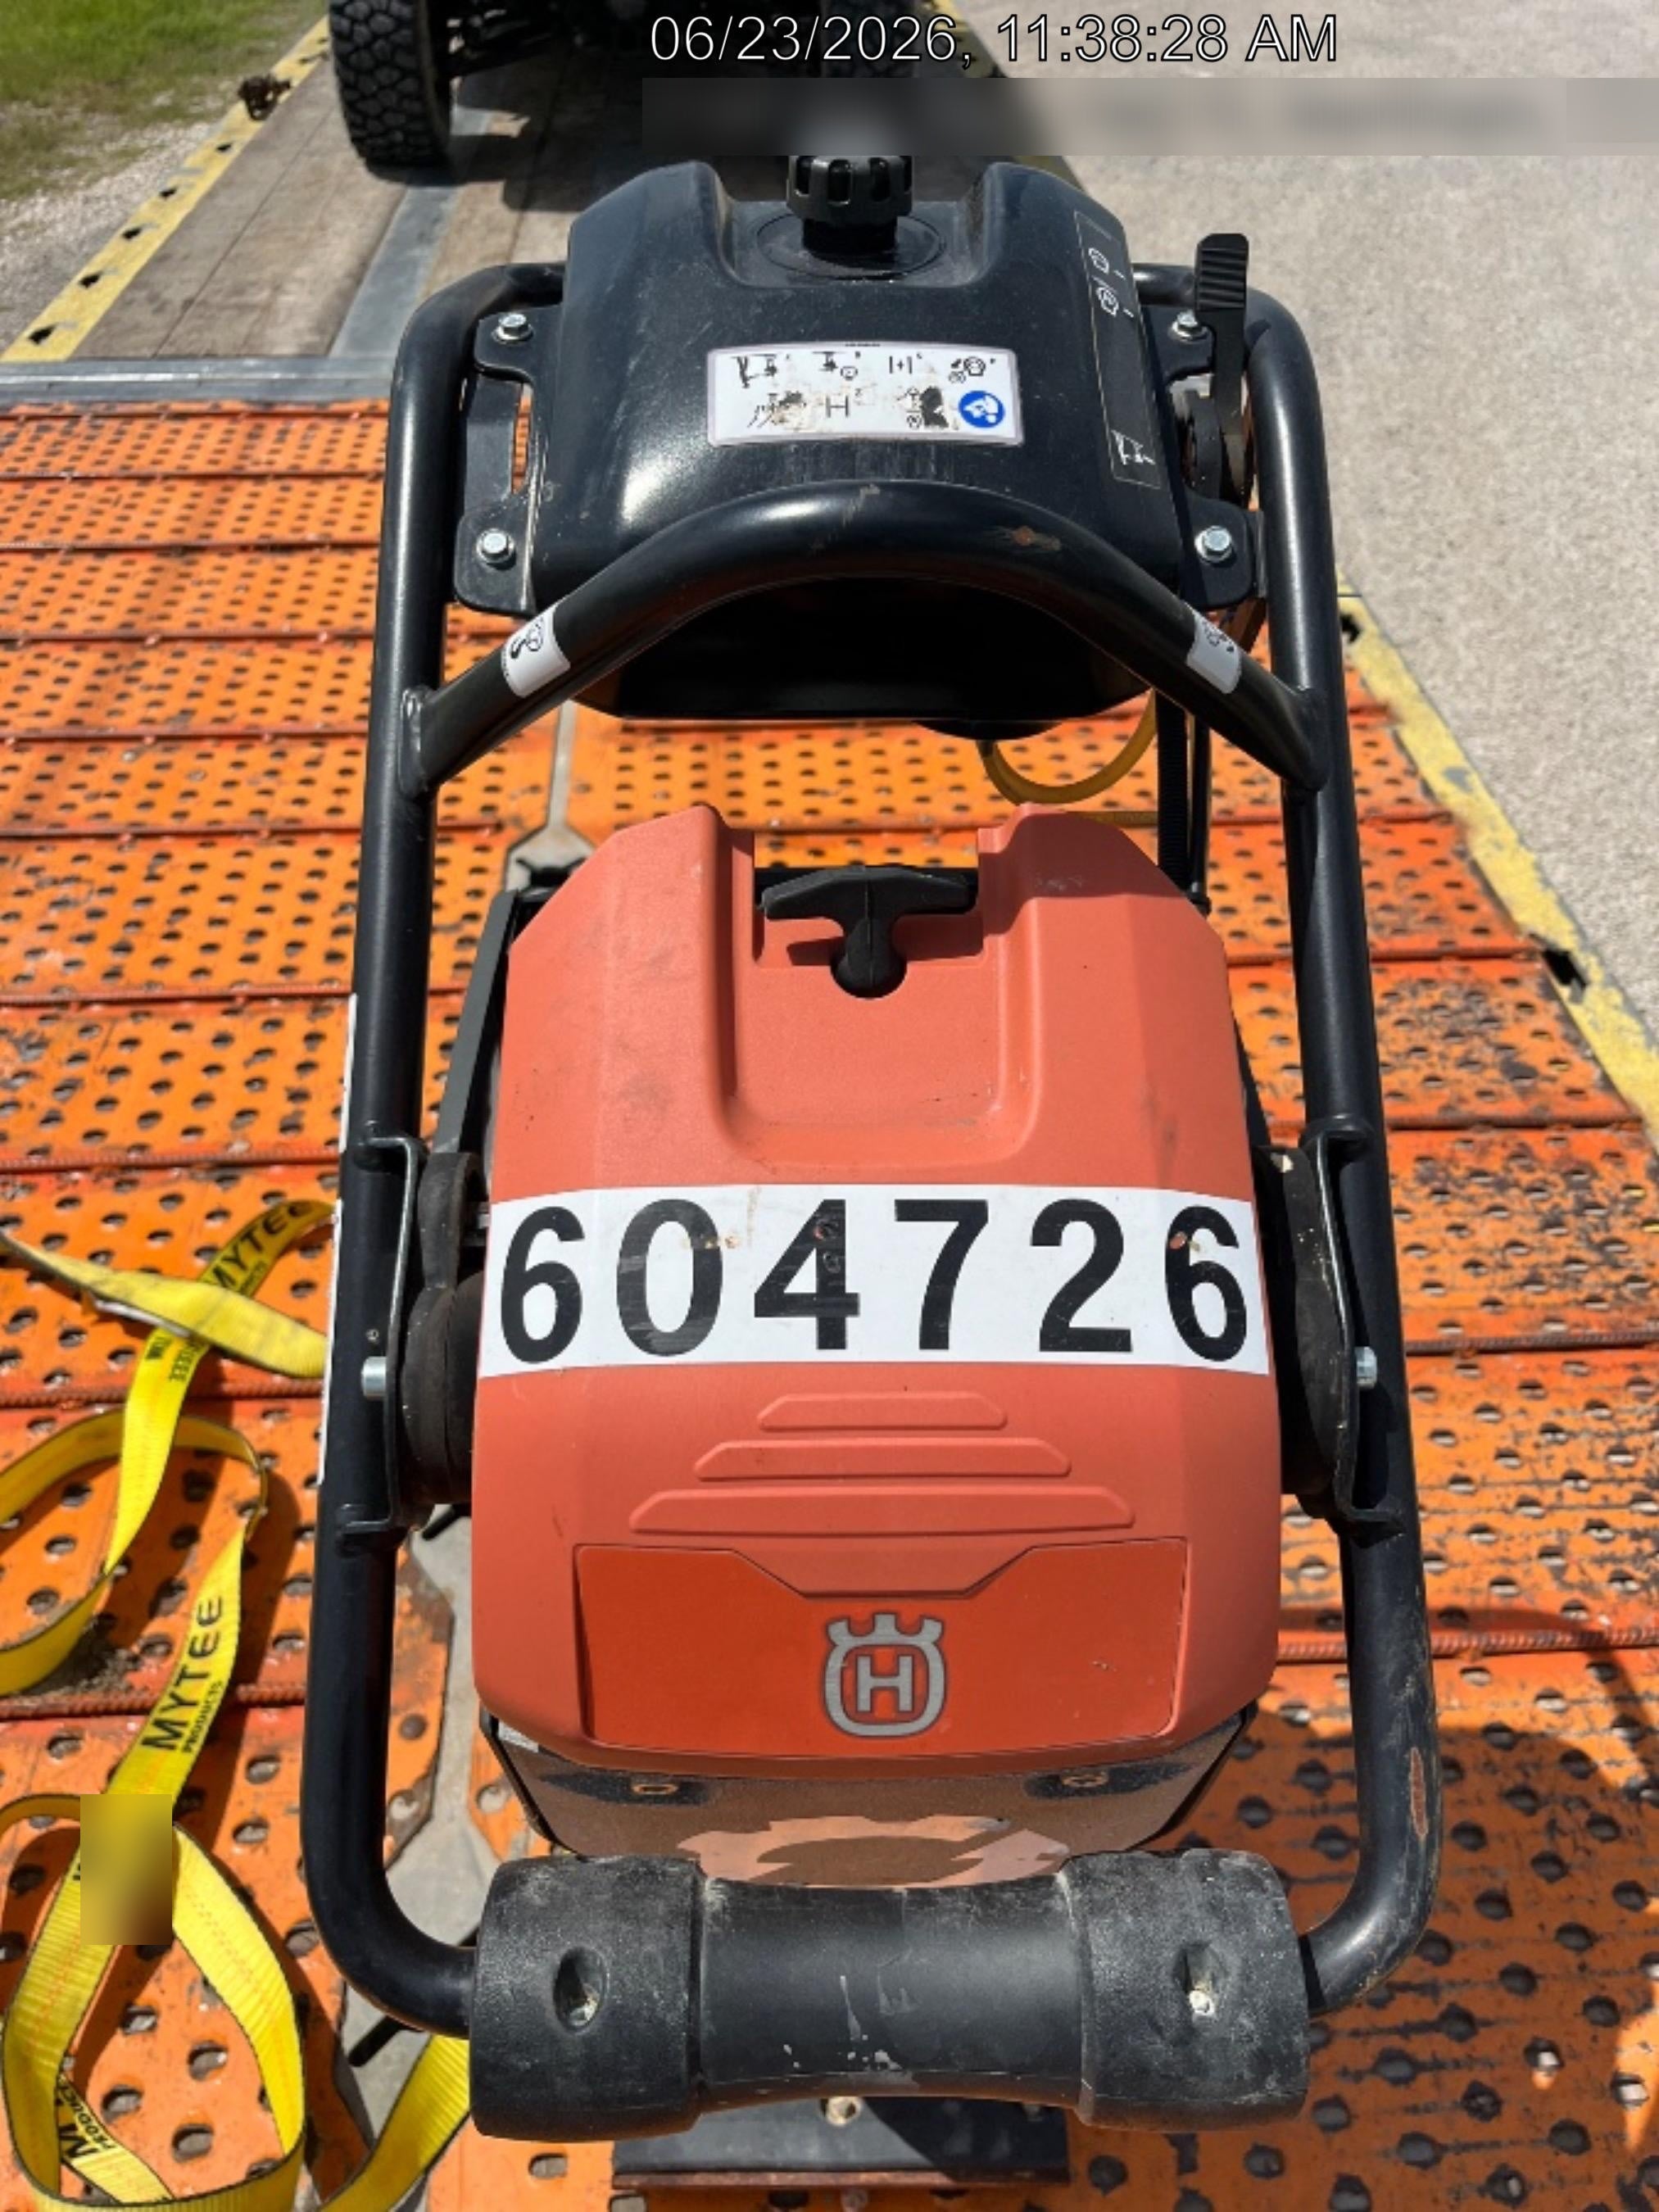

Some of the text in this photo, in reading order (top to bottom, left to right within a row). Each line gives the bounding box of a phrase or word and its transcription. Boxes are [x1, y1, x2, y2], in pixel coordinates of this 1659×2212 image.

[499, 1198, 1250, 1364] 604726
[141, 1593, 224, 1751] MYTEE
[181, 1678, 224, 1753] PRODUCTS
